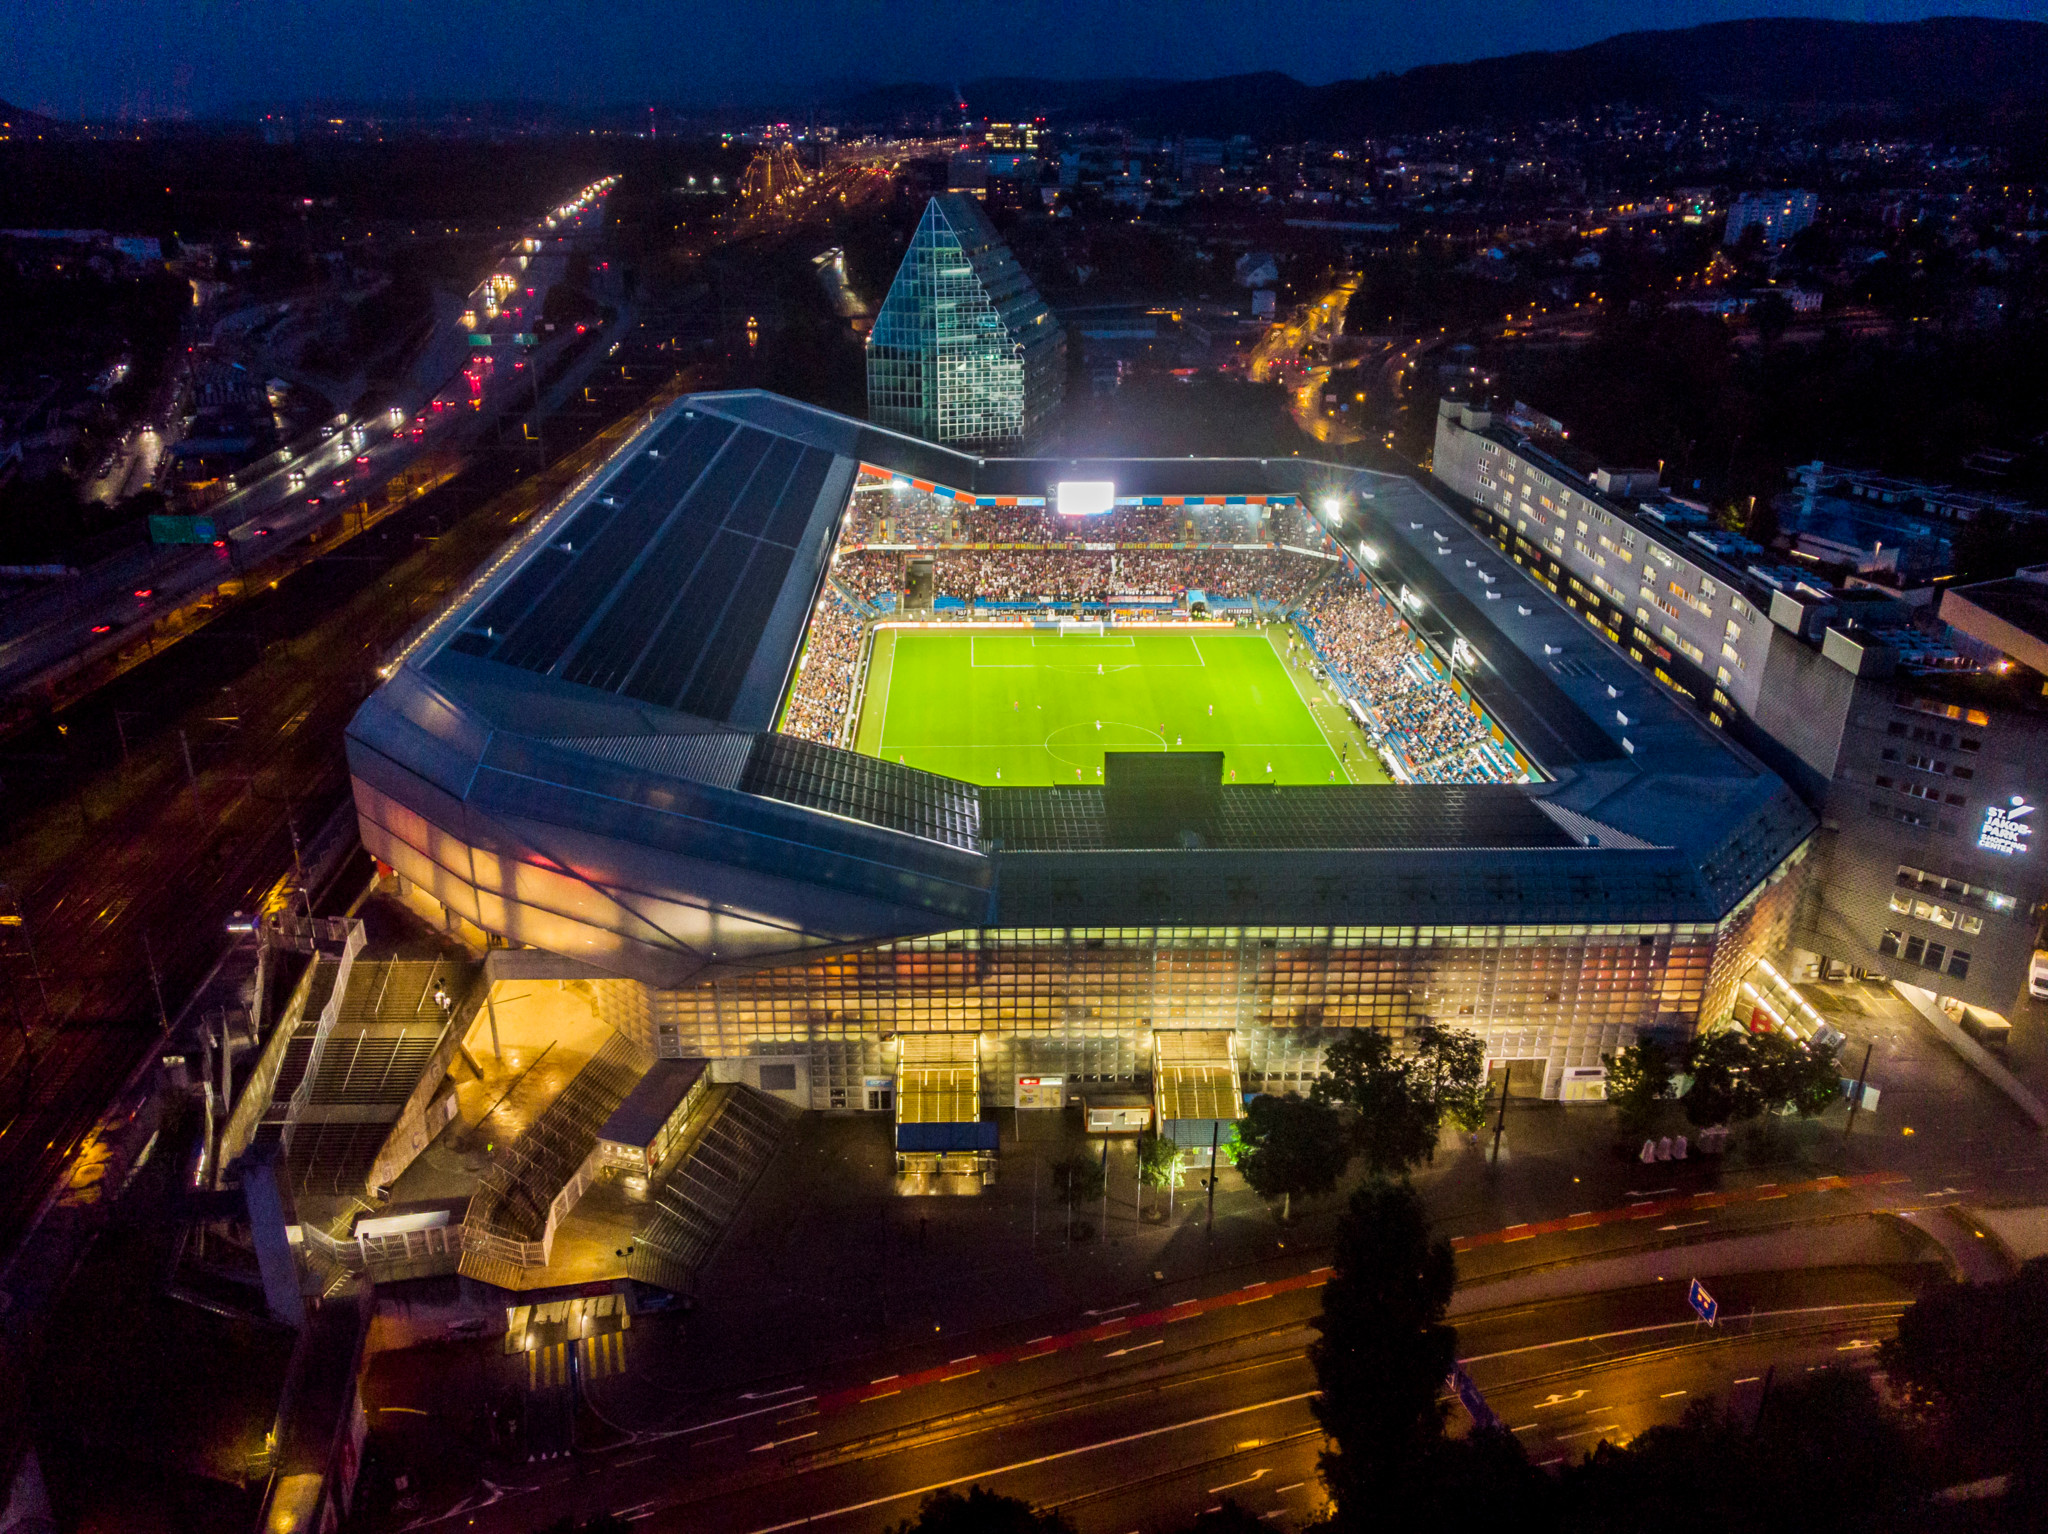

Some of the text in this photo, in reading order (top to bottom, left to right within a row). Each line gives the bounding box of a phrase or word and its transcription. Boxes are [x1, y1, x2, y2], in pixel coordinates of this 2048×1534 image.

[1987, 806, 2006, 819] ST.
[1982, 824, 2019, 842] PARK
[1978, 839, 2014, 854] CENTER
[1980, 833, 2028, 852] SHOPPING
